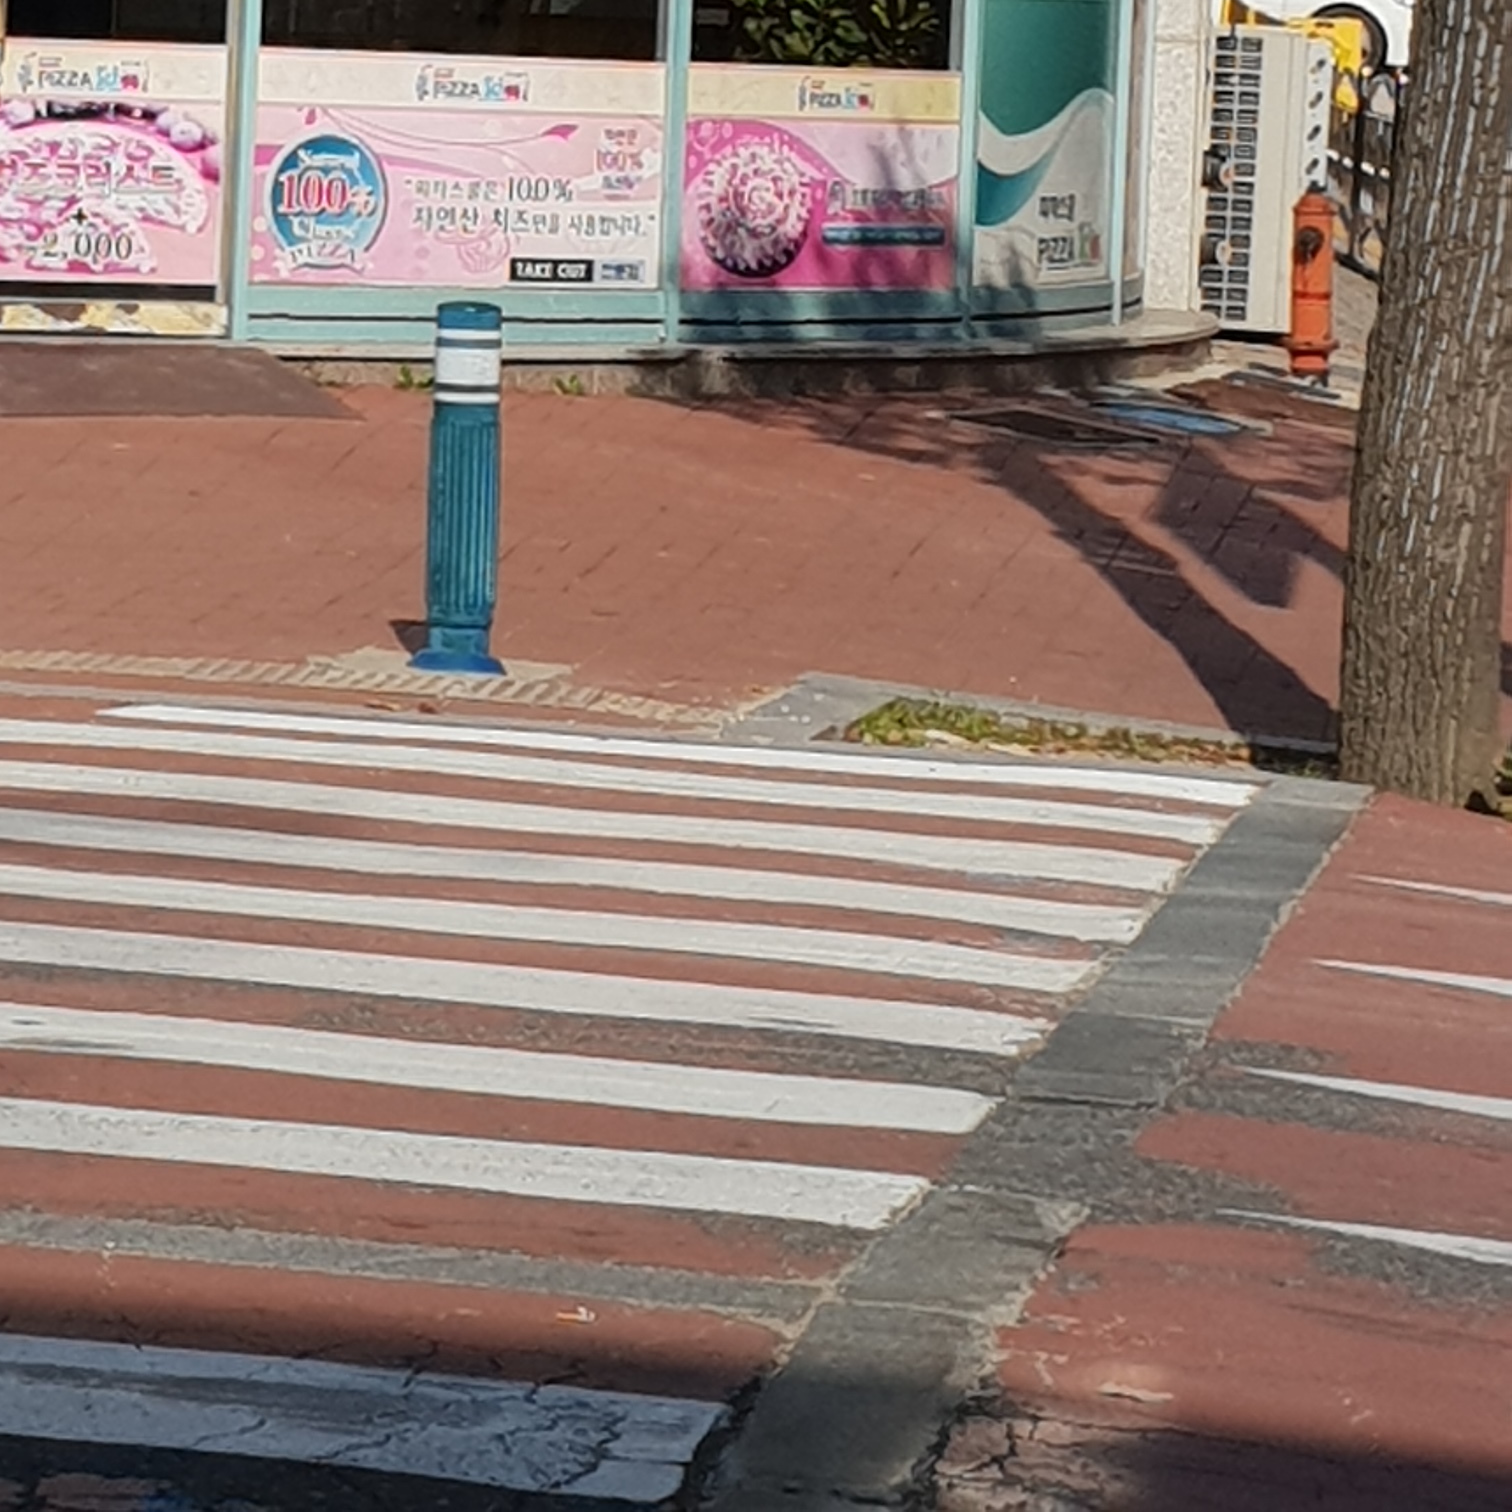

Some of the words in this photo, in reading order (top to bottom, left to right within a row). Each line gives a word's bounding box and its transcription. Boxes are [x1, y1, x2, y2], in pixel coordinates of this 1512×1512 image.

[277, 169, 378, 219] 100%
[506, 175, 576, 204] 100%
[515, 260, 554, 281] TAKE
